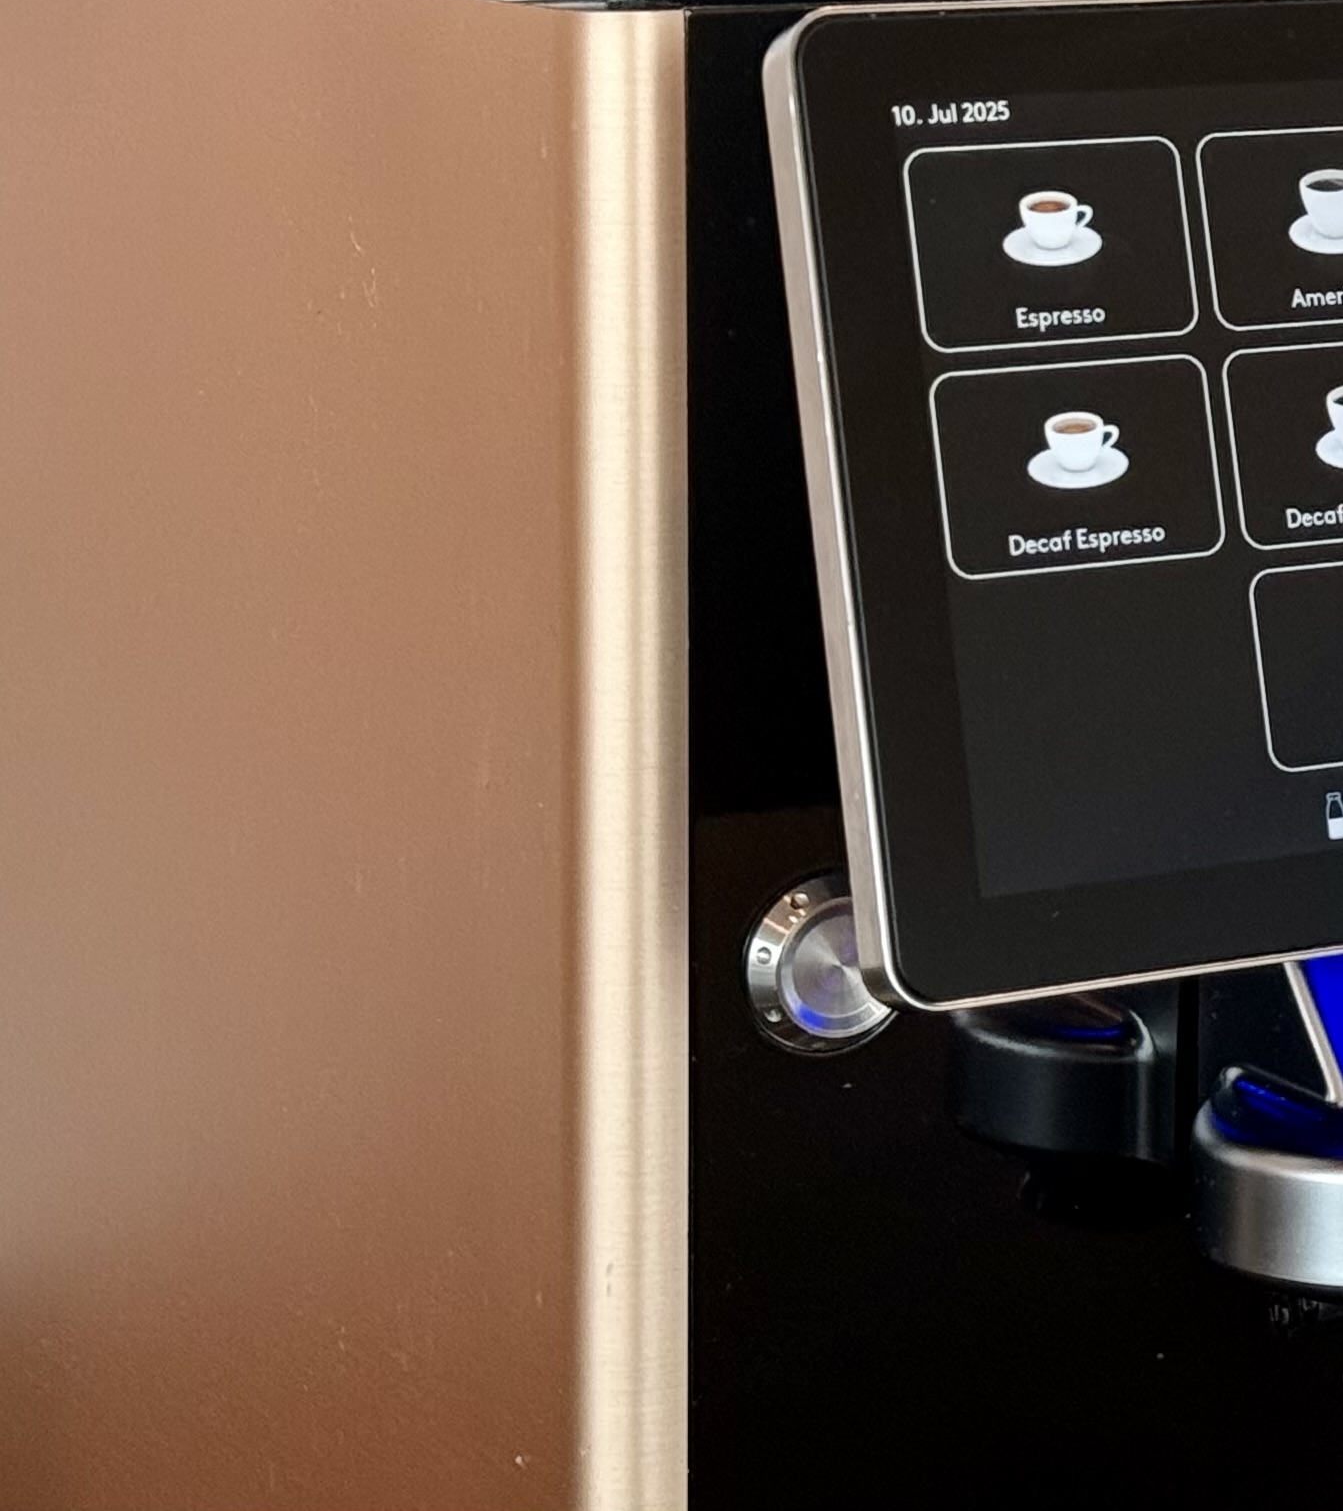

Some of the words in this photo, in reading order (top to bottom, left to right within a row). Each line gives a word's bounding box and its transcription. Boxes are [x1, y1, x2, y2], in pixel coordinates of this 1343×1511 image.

[892, 105, 923, 126] 10.
[928, 103, 958, 124] Jul
[961, 100, 1010, 123] 2025
[1016, 307, 1105, 332] Espresso
[1009, 530, 1072, 556] Decaf
[1076, 525, 1166, 551] Espresso
